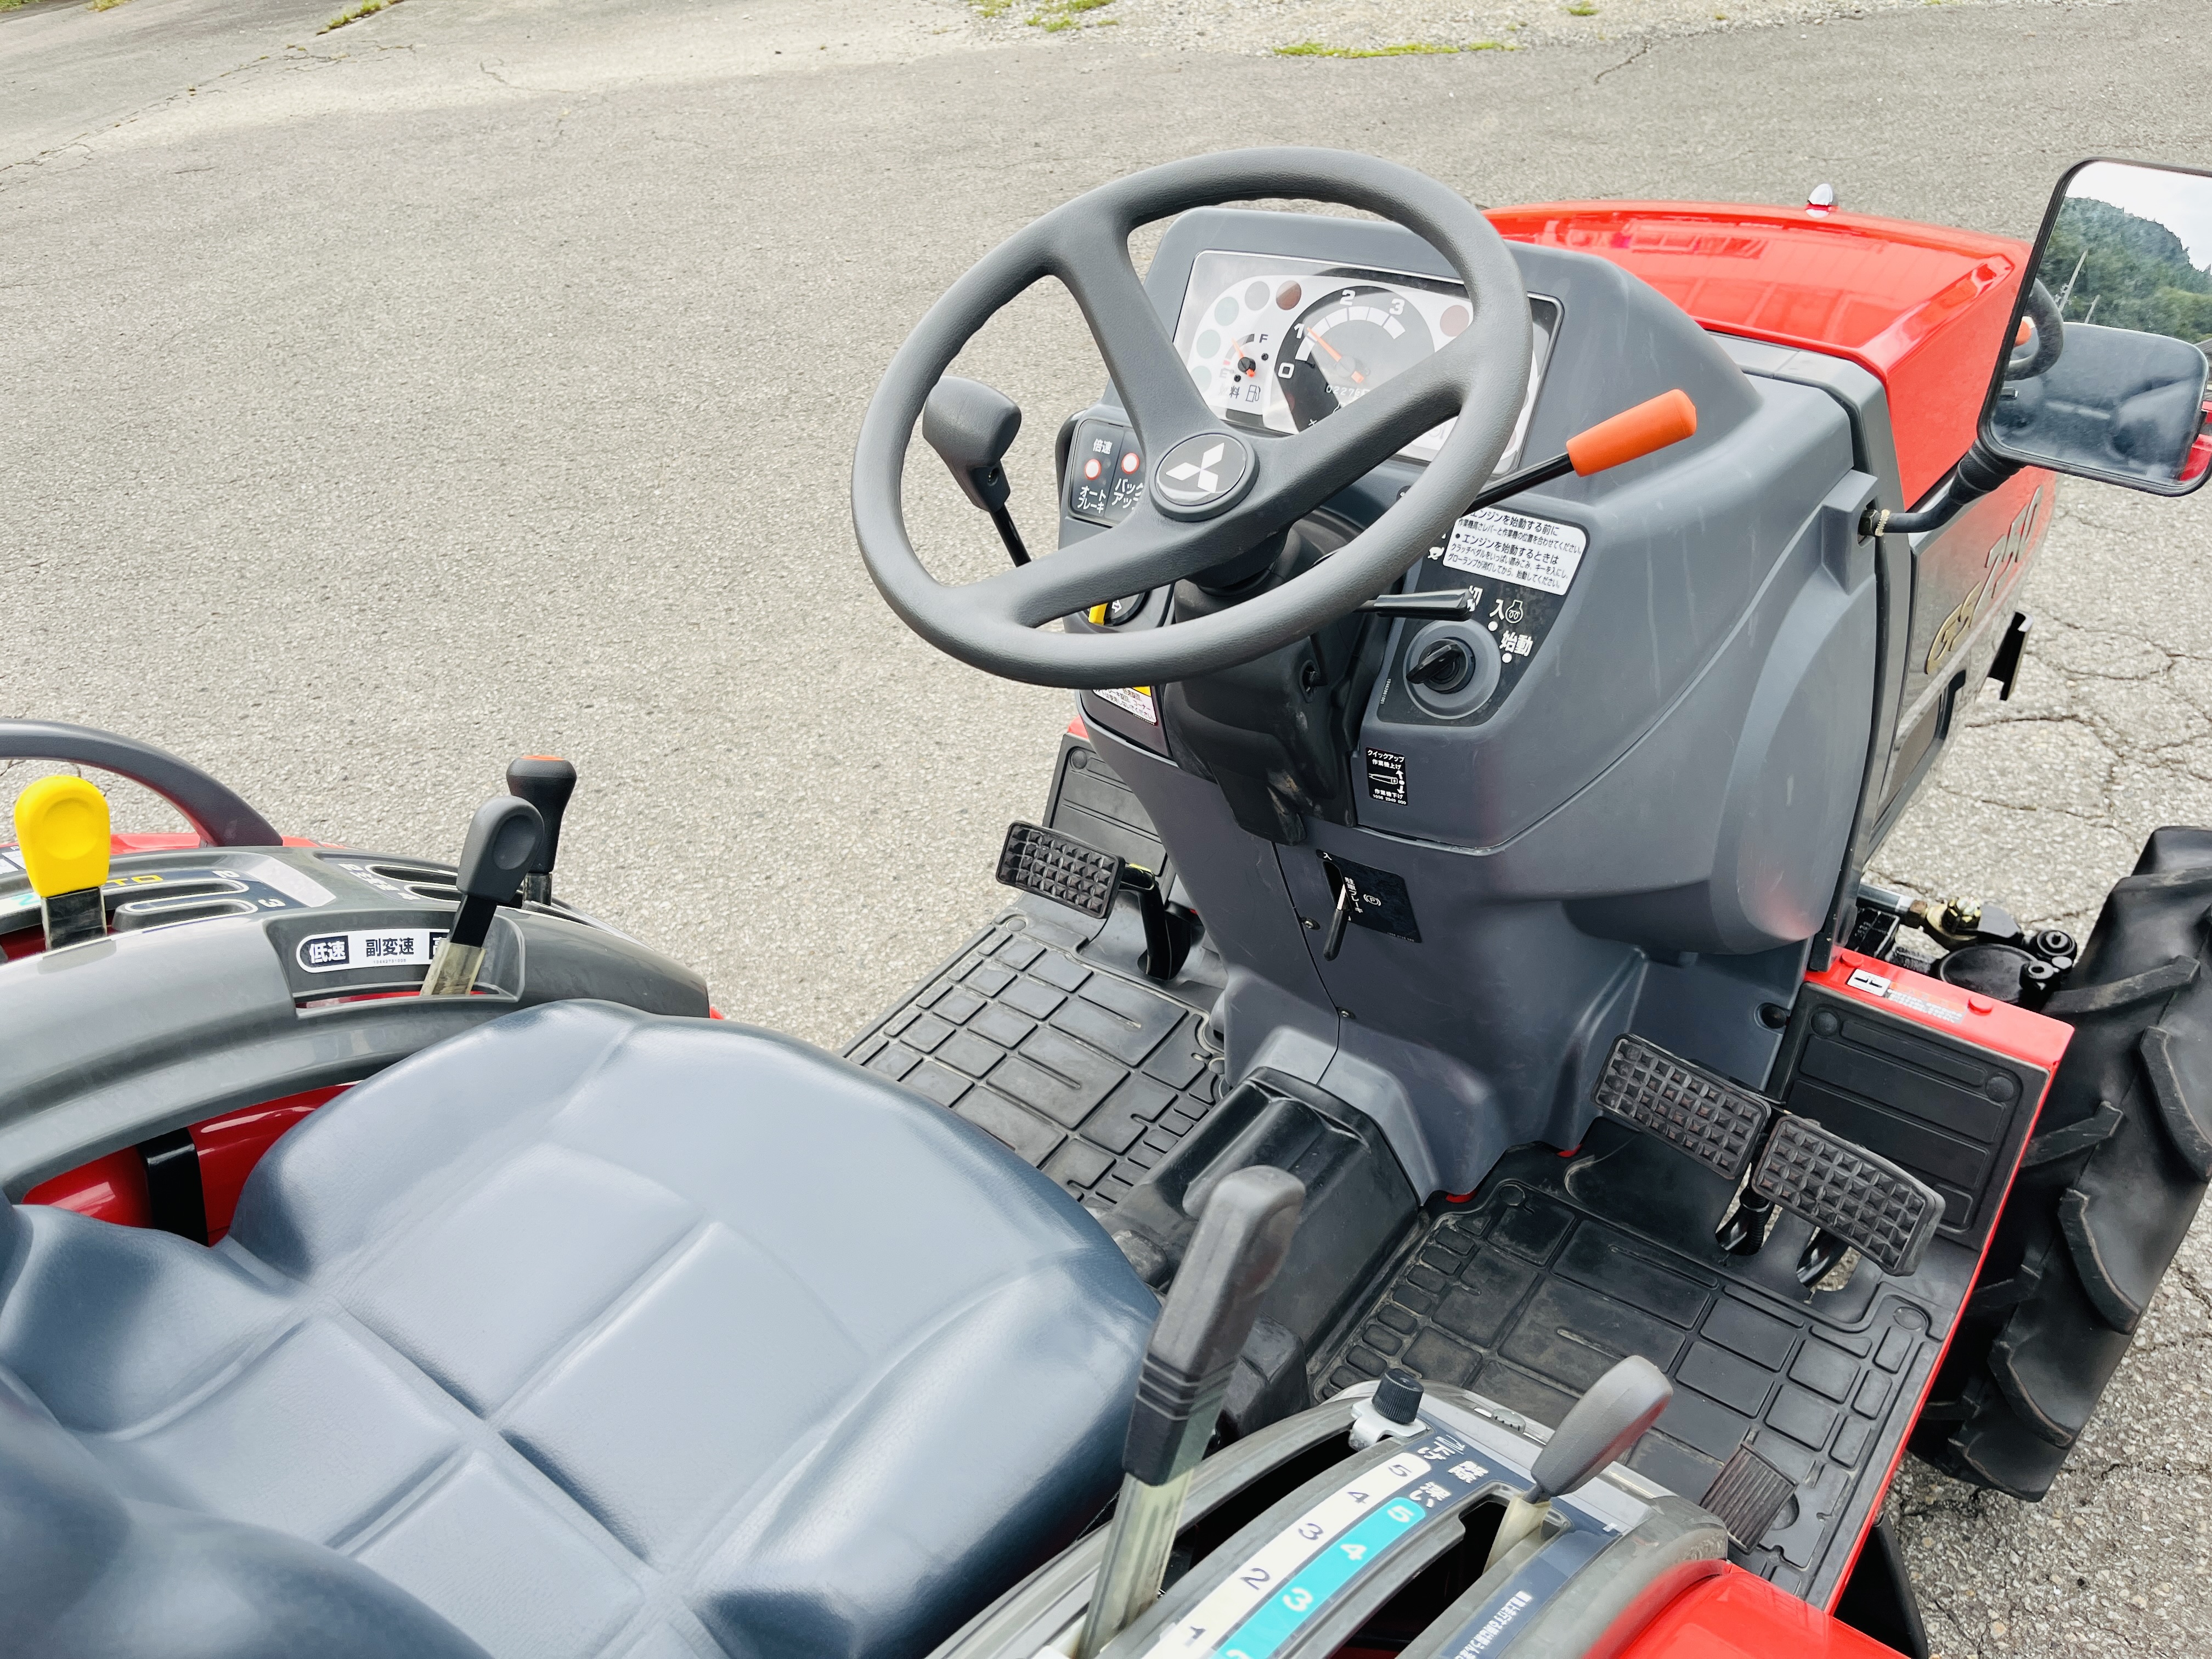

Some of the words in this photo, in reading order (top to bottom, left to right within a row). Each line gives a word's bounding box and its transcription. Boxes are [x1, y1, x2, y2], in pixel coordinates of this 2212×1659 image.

[1339, 290, 1356, 306] 2
[1389, 298, 1405, 315] 3
[1259, 334, 1268, 343] F
[1294, 323, 1305, 339] 1
[1219, 368, 1229, 379] E
[1278, 362, 1295, 379] 0
[1092, 438, 1113, 455] 倍速
[1080, 486, 1107, 501] オート
[1470, 510, 1560, 536] エンジンを始動する前に
[1462, 534, 1559, 565] エンジンを始動するときは
[1489, 599, 1505, 620] 入
[1499, 630, 1533, 657] 始動
[1368, 749, 1405, 763] クイックアップ
[1372, 759, 1402, 770] 作業機上げ
[1374, 788, 1403, 799] 作業機下げ
[105, 874, 163, 886] TO
[309, 940, 346, 964] 低速
[365, 936, 414, 957] 副変速
[1417, 1441, 1455, 1460] 下げ
[1388, 1464, 1412, 1477] 5
[1448, 1460, 1489, 1483] 解除
[1347, 1491, 1370, 1504] 4
[1409, 1481, 1451, 1508] 深い
[1386, 1505, 1414, 1523] 5
[1298, 1523, 1324, 1541] 3
[1340, 1543, 1367, 1561] 4
[1240, 1568, 1271, 1590] 2
[1282, 1587, 1313, 1612] 3
